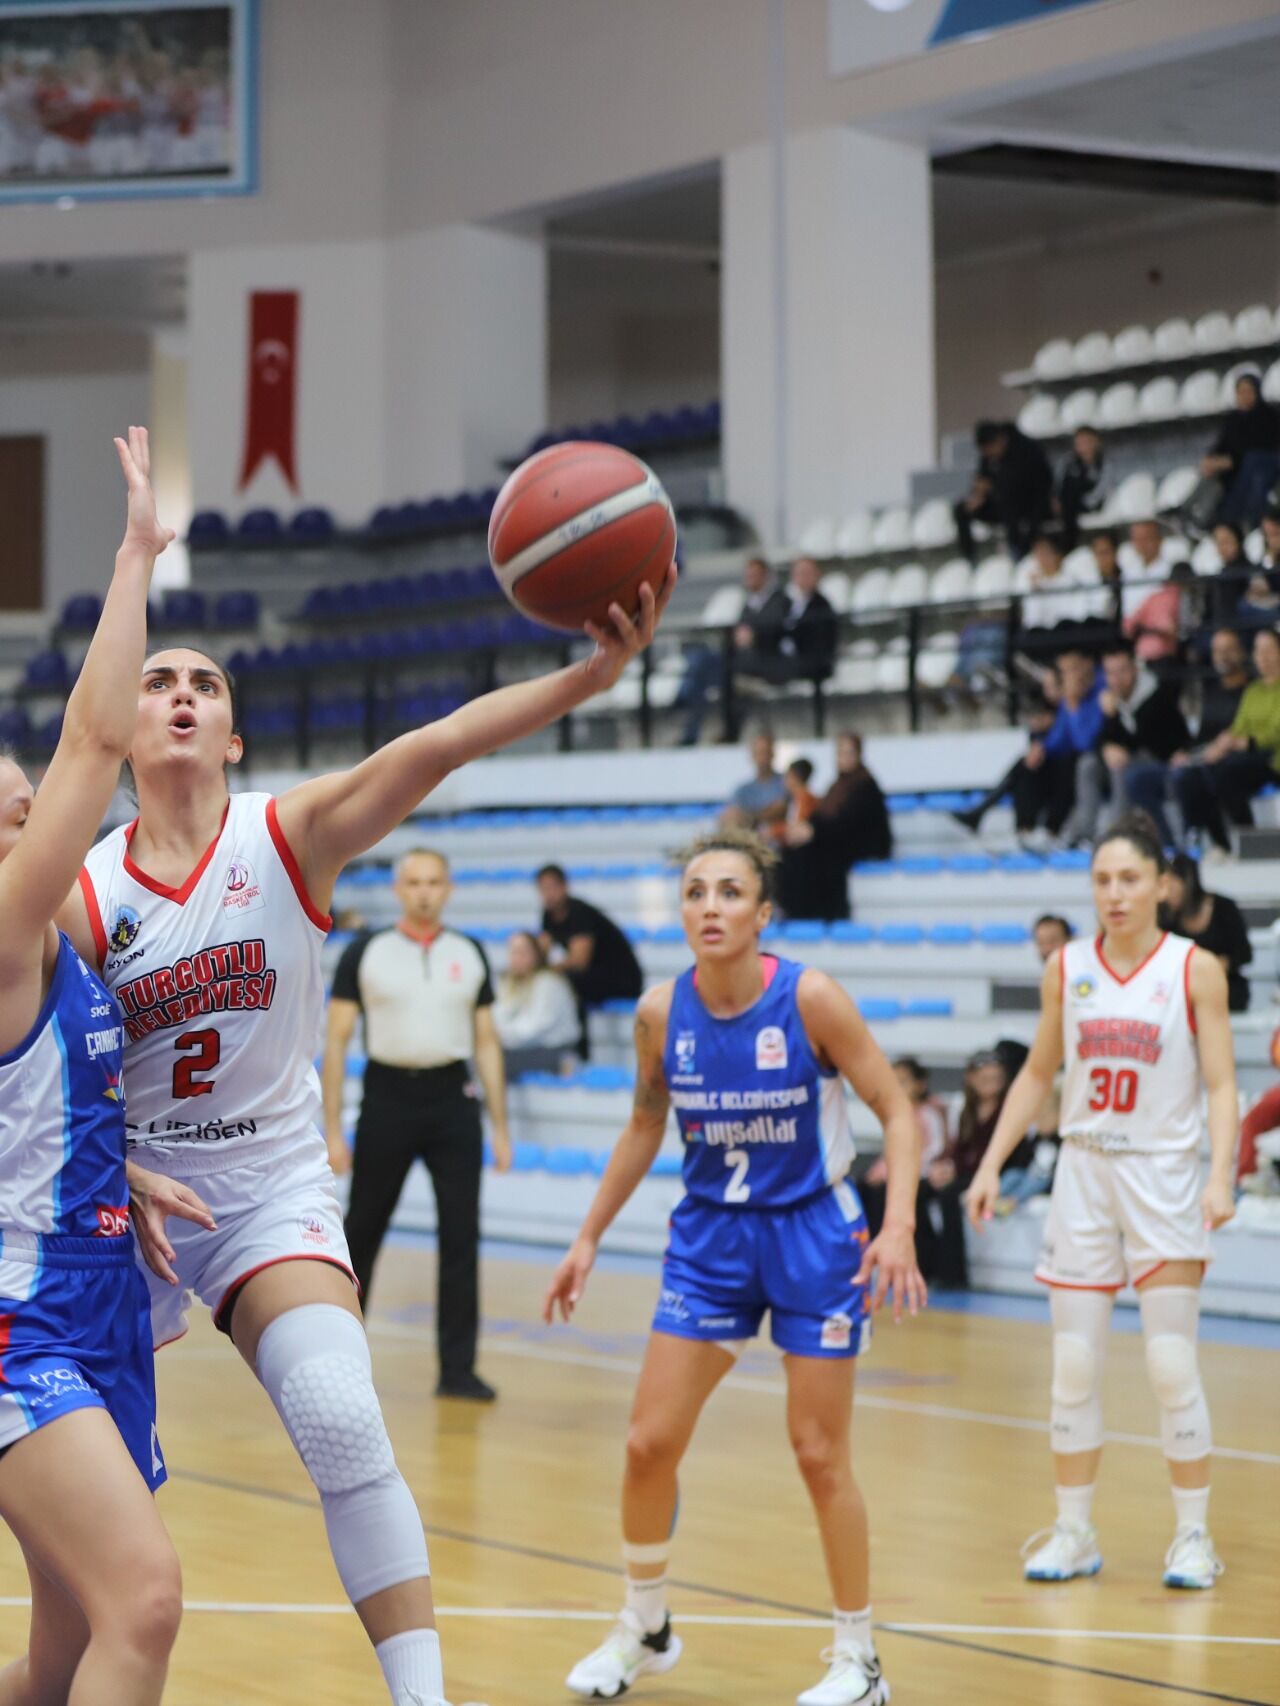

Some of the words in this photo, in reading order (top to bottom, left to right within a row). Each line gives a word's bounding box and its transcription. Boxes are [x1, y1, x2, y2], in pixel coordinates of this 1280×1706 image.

[116, 939, 266, 1016] TURGUTLU
[172, 1028, 220, 1099] 2
[1088, 1068, 1139, 1113] 30
[723, 1150, 751, 1203] 2
